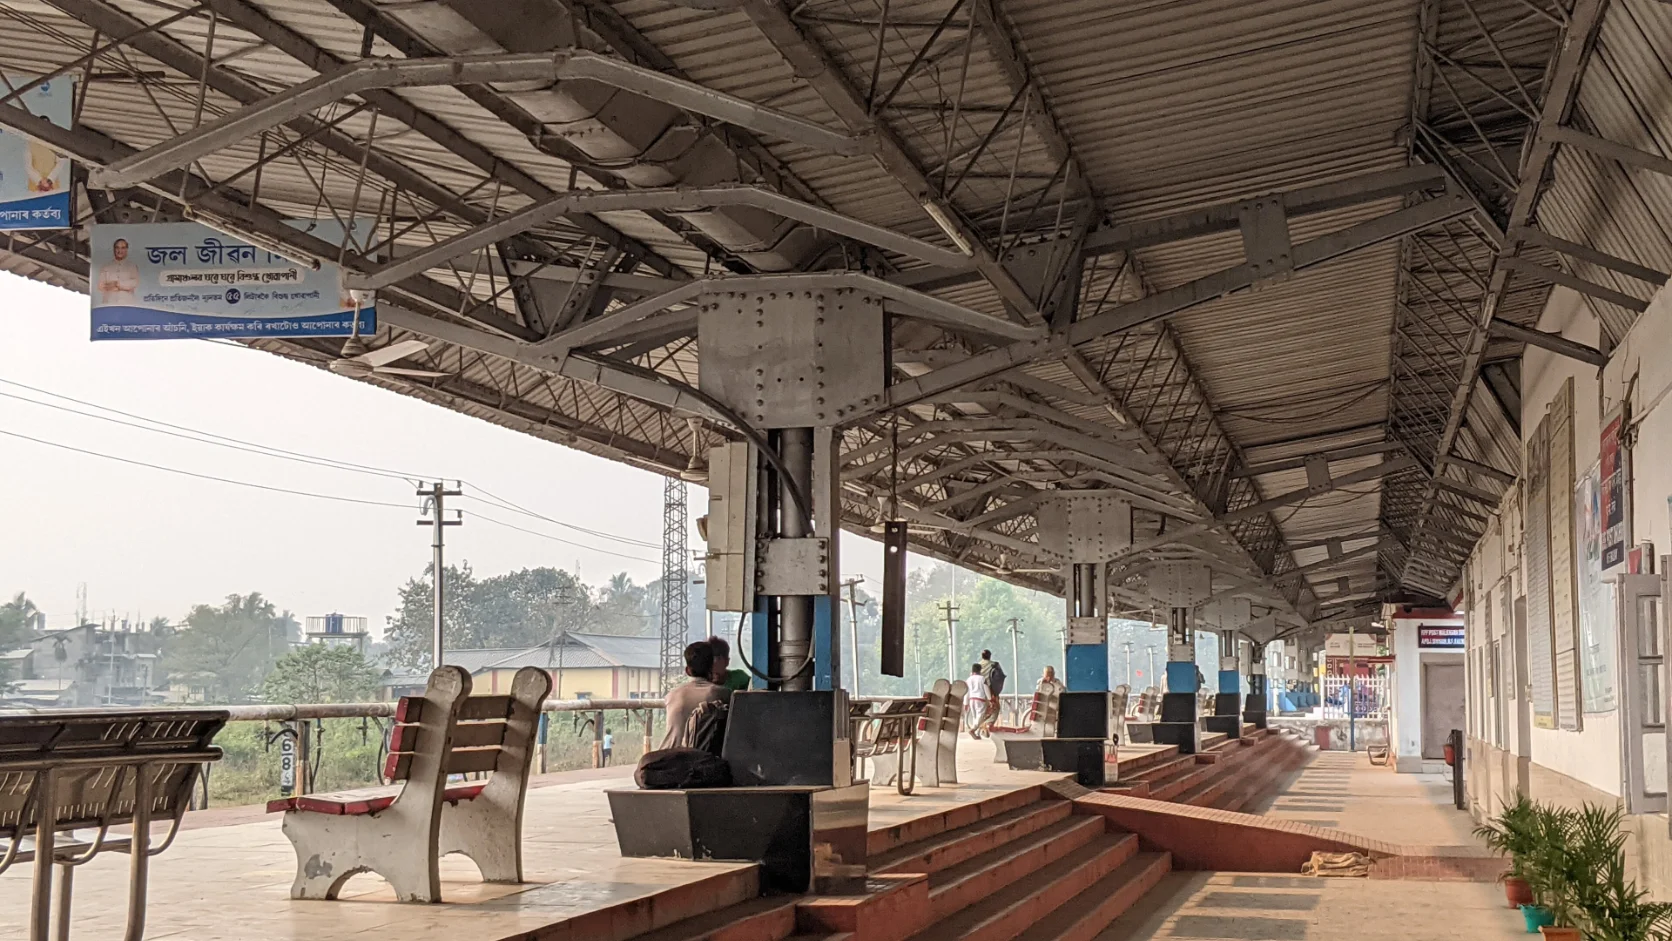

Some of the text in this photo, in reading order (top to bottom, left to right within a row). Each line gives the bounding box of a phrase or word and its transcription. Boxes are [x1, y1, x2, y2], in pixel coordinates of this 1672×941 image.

[145, 246, 188, 266] জল
[195, 238, 257, 265] জীৱন
[226, 292, 240, 300] ৫৫
[282, 738, 291, 752] 6
[282, 757, 291, 770] 8
